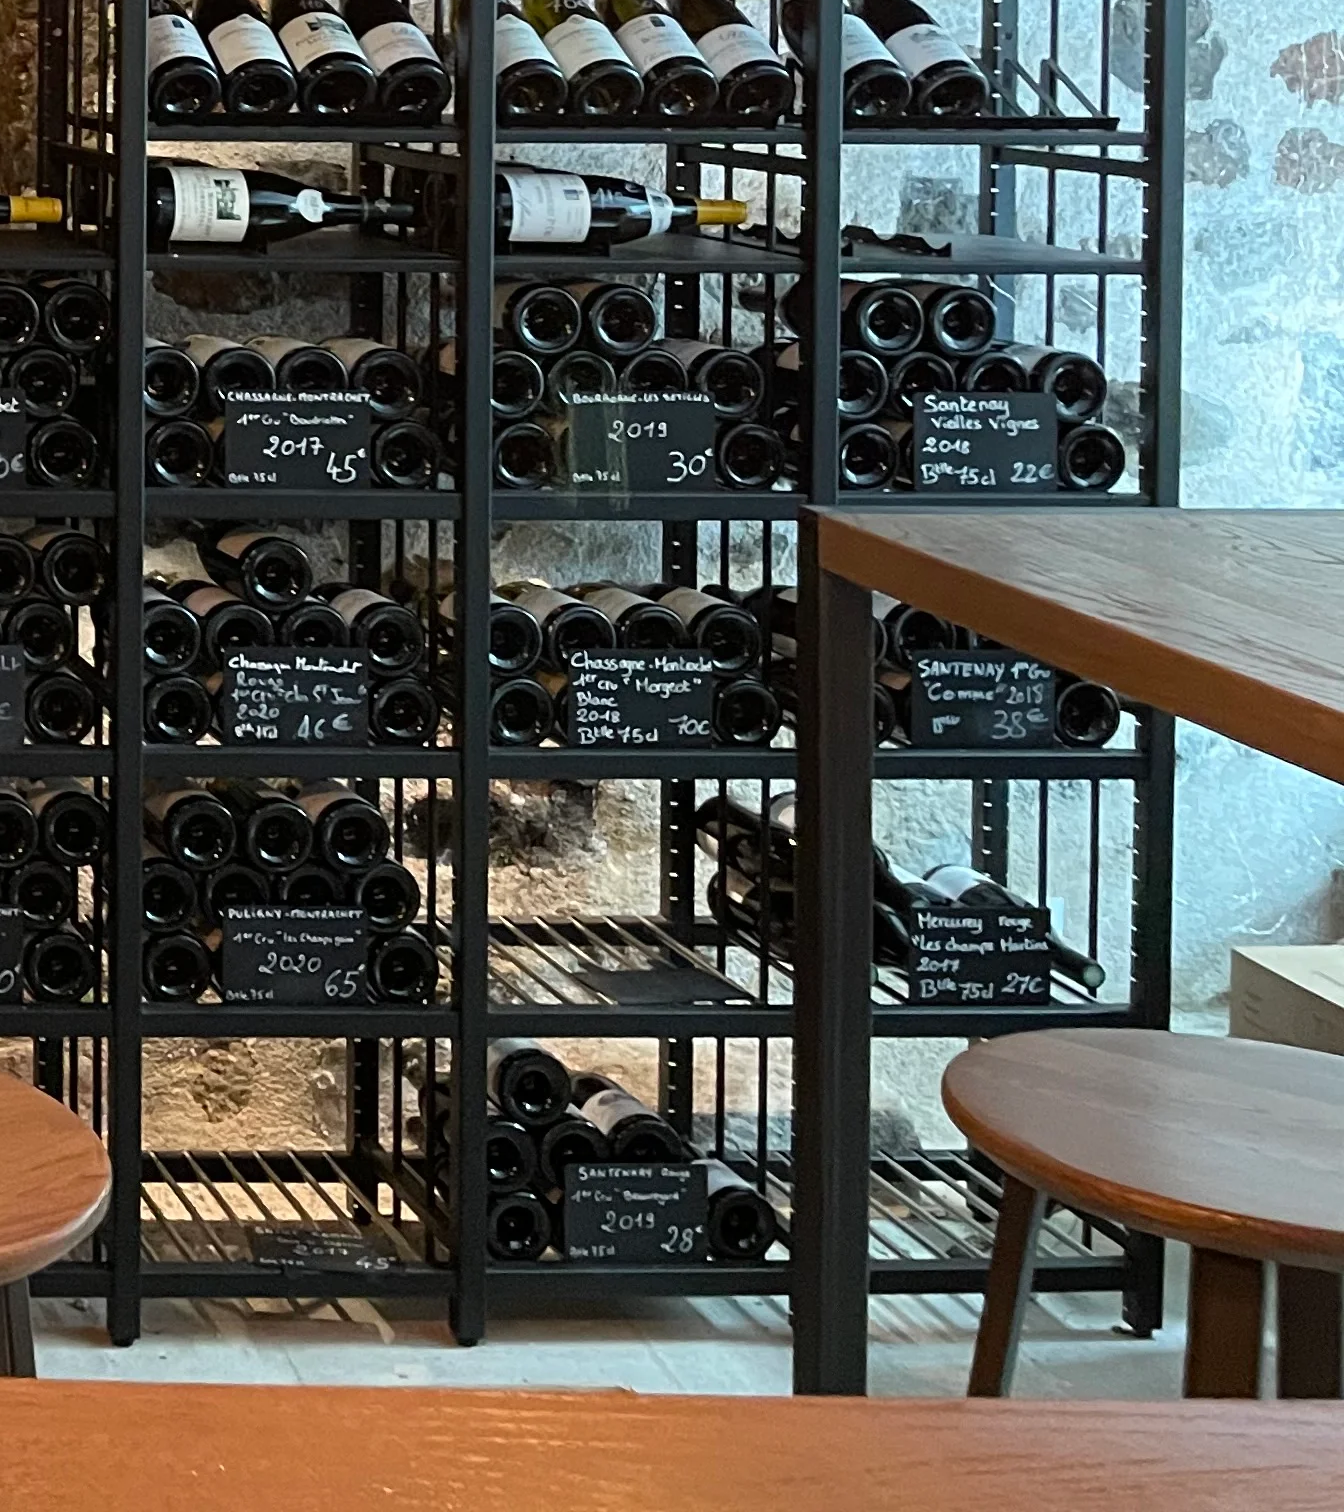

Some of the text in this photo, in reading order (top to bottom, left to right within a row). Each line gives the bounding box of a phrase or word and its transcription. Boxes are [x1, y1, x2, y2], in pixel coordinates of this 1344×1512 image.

[923, 394, 1010, 421] Santenay
[608, 419, 669, 443] 2019
[262, 434, 325, 459] 2017
[917, 658, 1007, 684] SANTENAY
[576, 707, 622, 724] 2018
[257, 951, 323, 975] 2020
[599, 1208, 657, 1234] 2019
